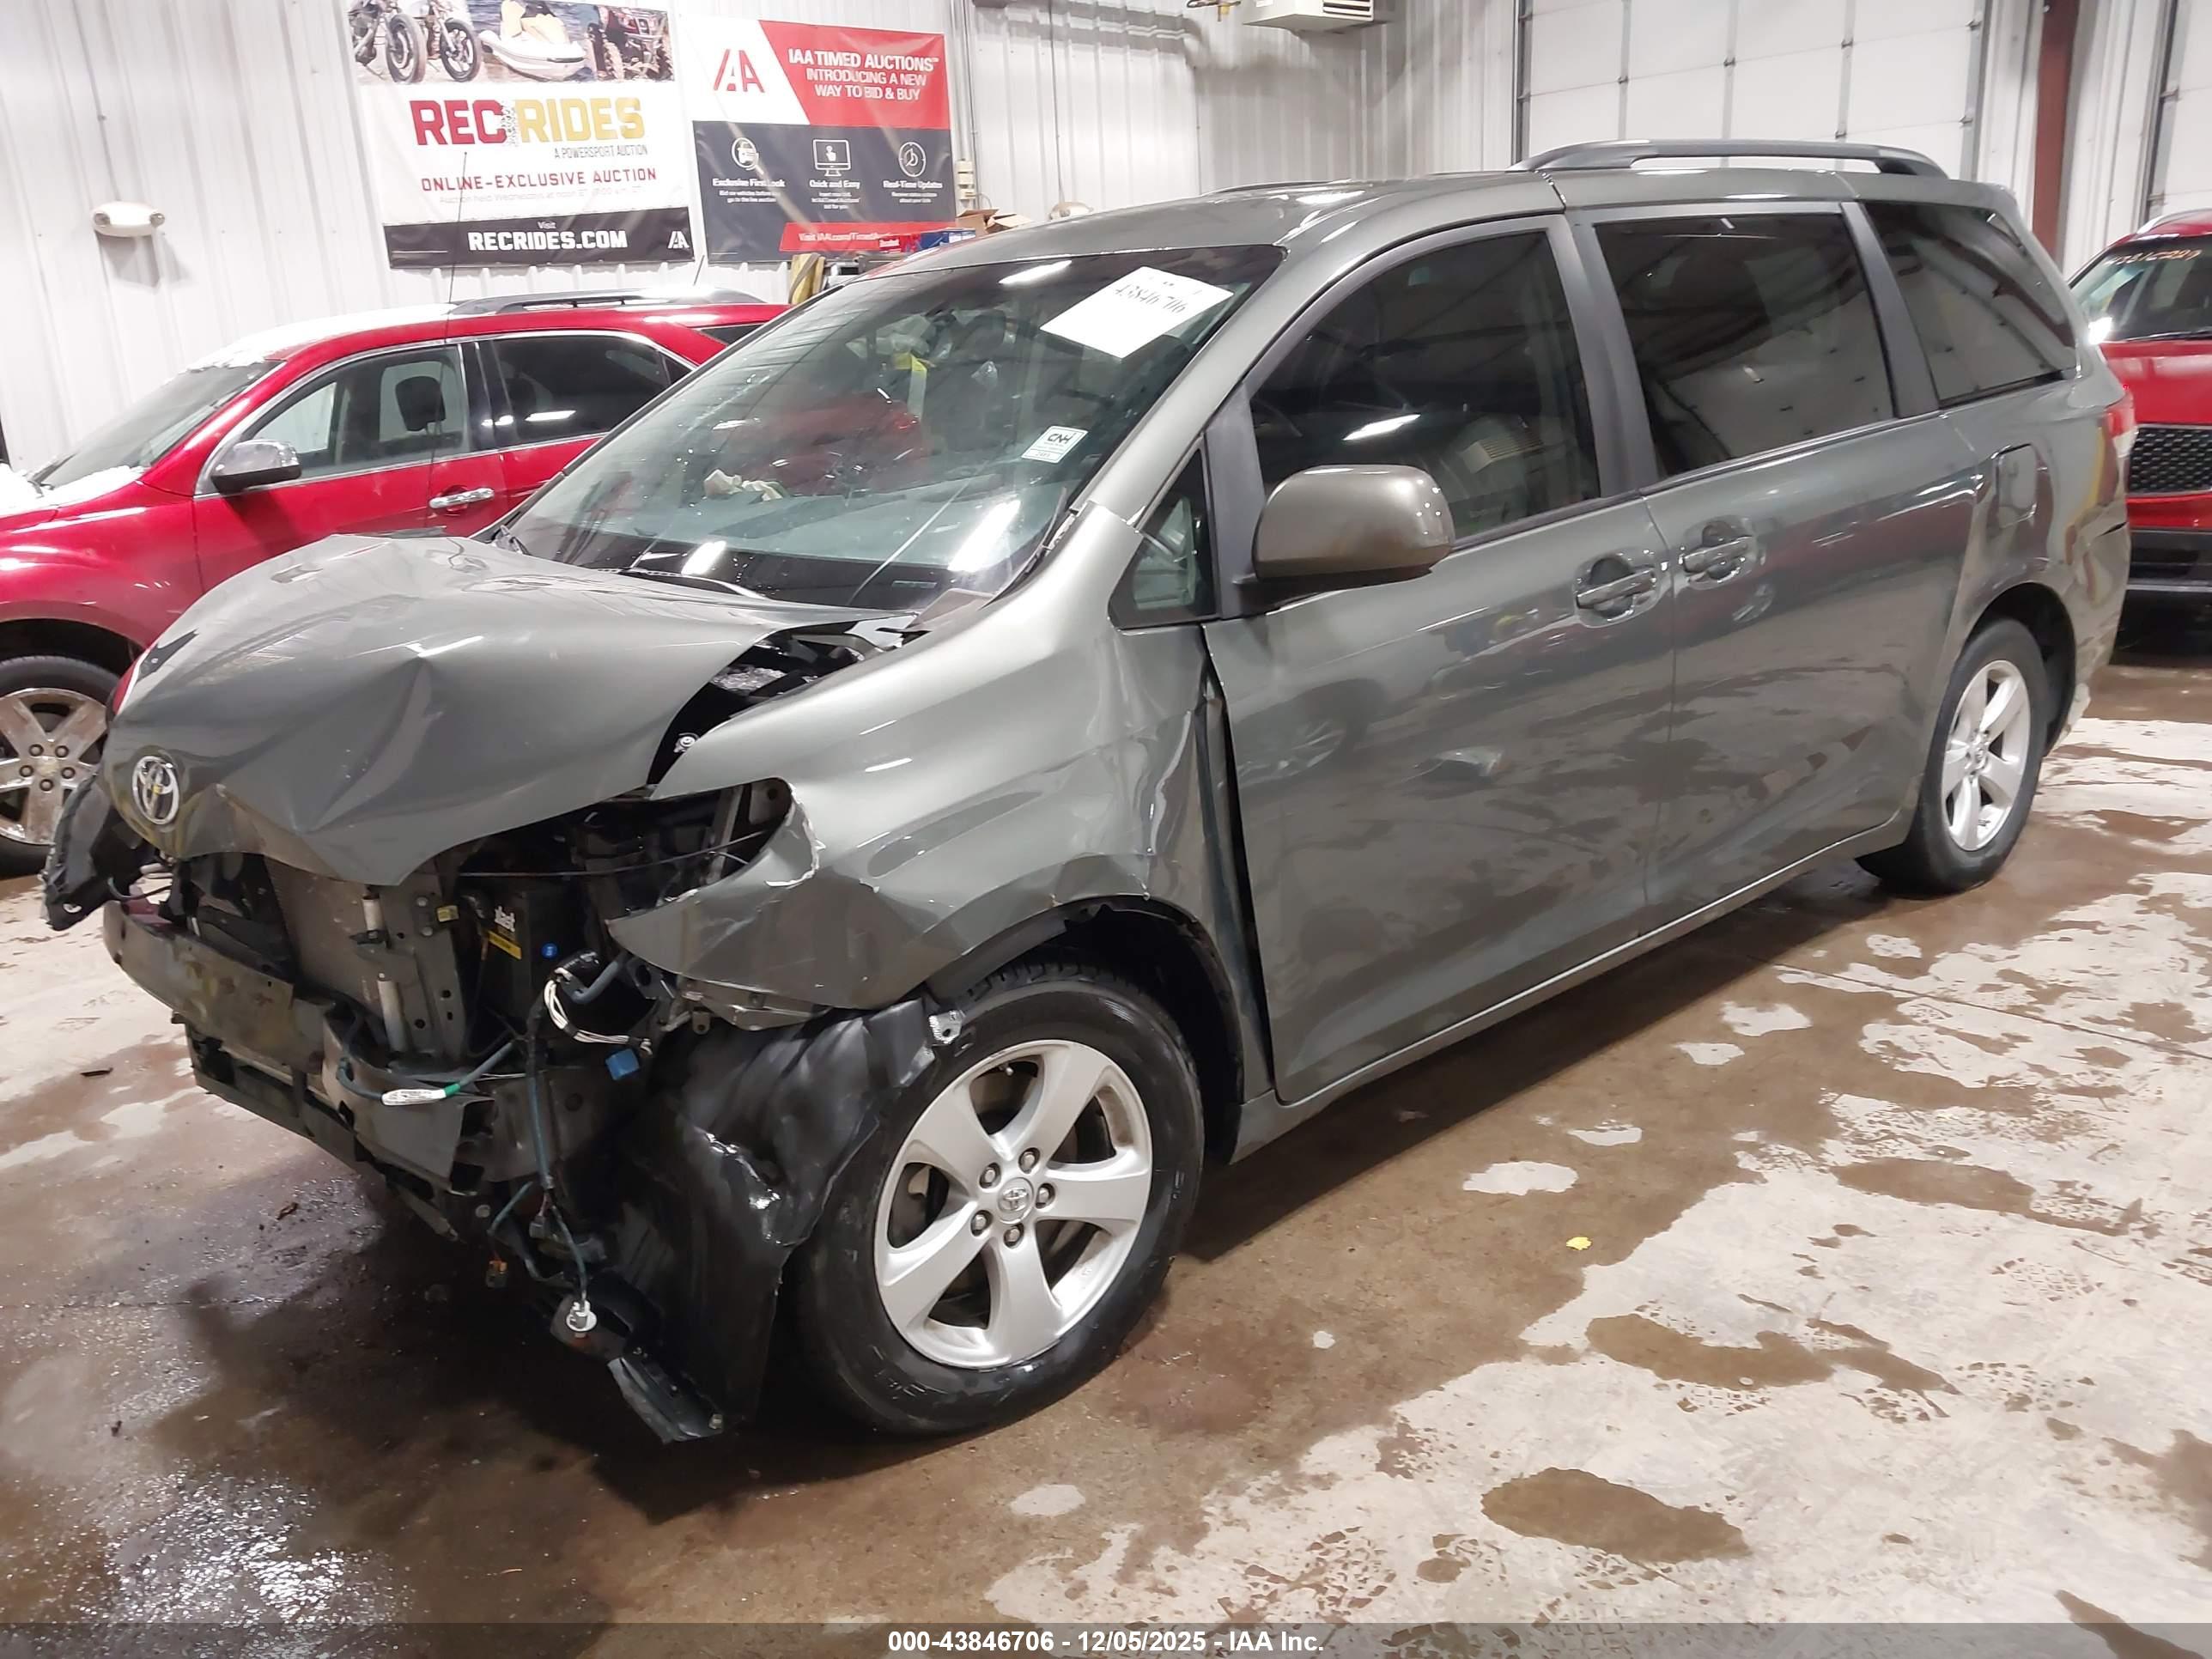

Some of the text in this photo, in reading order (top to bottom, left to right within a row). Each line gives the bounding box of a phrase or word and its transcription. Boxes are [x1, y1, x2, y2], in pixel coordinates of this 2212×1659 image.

[787, 48, 813, 64] IAA
[814, 50, 861, 69] TIMED
[805, 67, 927, 87] INTRODUCING A NEW
[813, 83, 921, 101] WAY TO BID & BUY
[410, 97, 645, 146] REC RIDES
[554, 143, 648, 159] A POWERSPORT AUCTION
[421, 171, 586, 192] ONLINE-EXCLUSIVE
[592, 167, 657, 184] AUCTION
[712, 178, 750, 186] Exclusive
[809, 179, 860, 190] Quick and Easy
[883, 179, 917, 189] Real-Time
[537, 220, 557, 230] Visit
[467, 230, 629, 252] RECRIDES.COM
[798, 233, 817, 242] Visit
